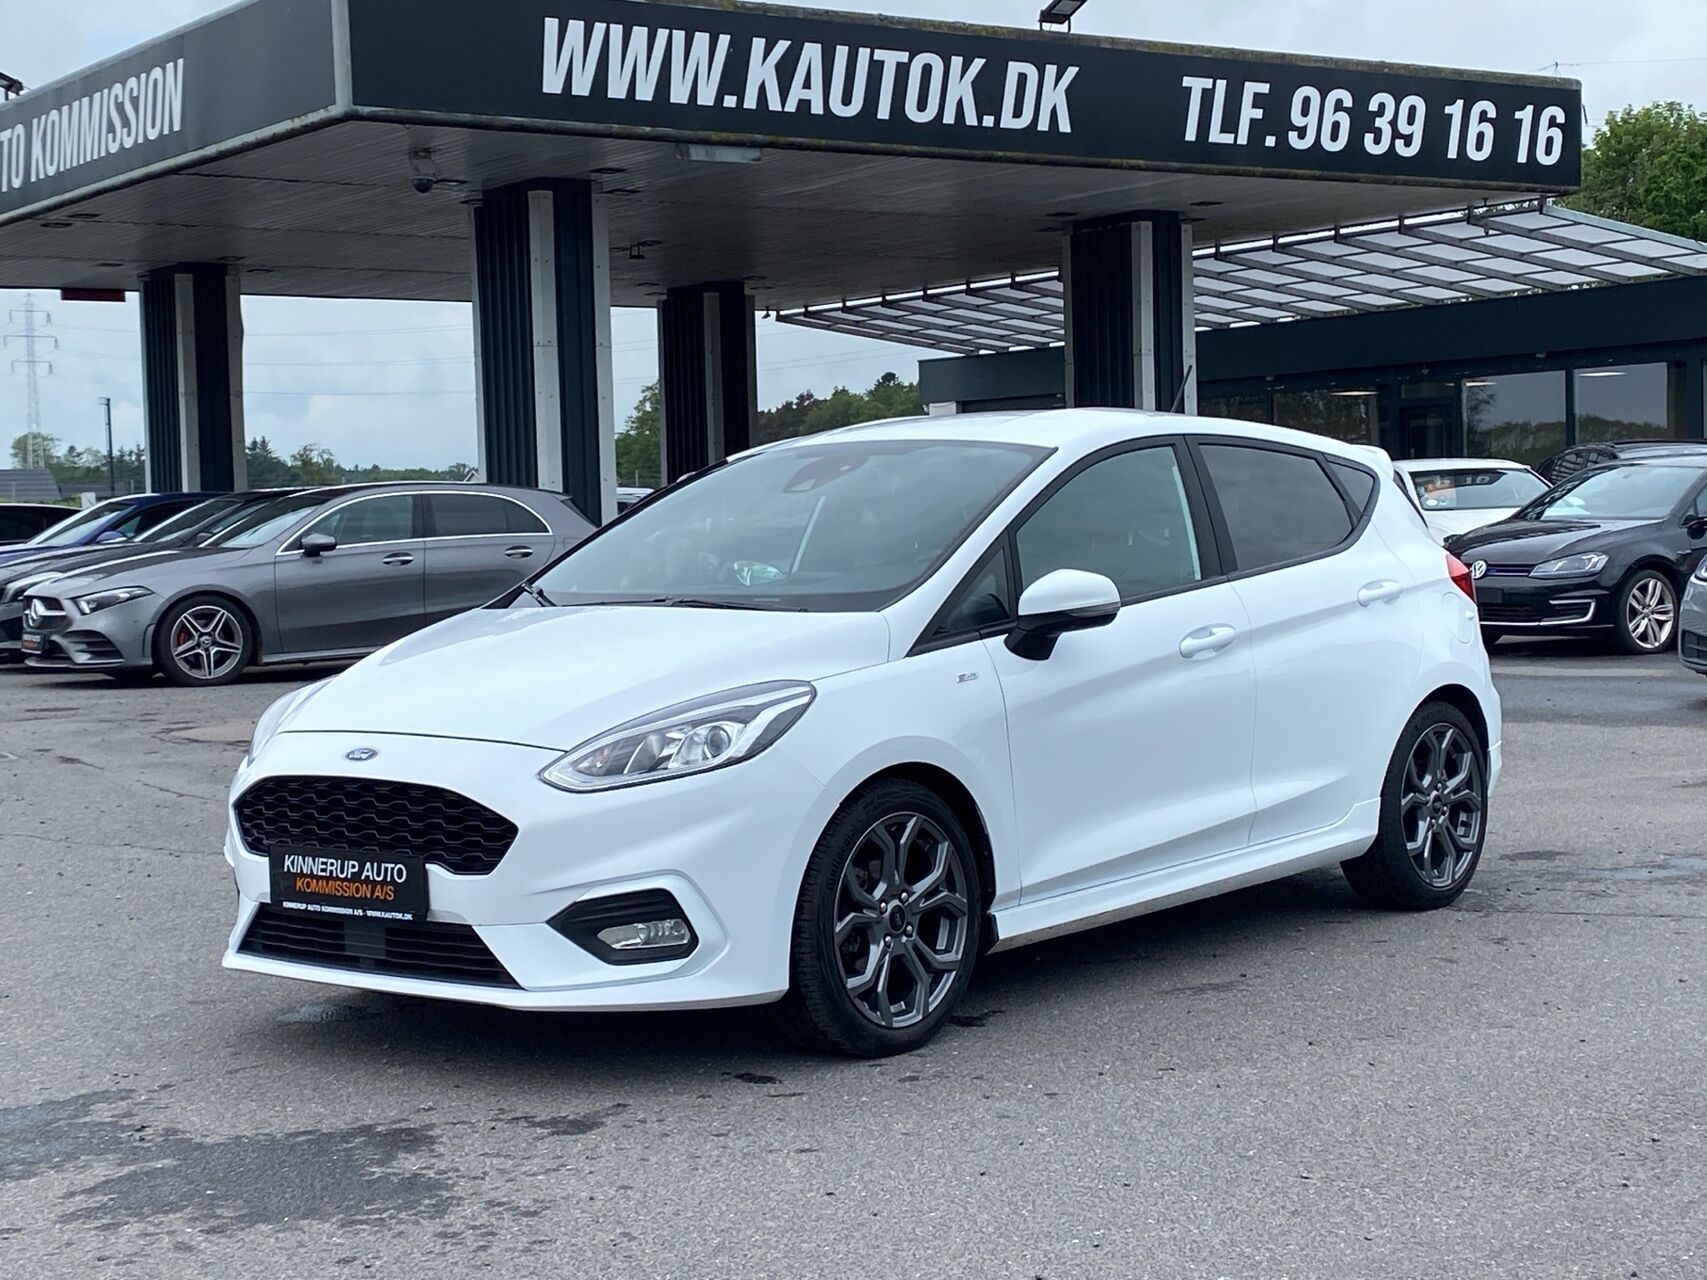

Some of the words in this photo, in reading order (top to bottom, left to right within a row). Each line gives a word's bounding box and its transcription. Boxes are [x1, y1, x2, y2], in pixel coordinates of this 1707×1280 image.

[542, 17, 1080, 133] WWW.KAUTOK.DK
[0, 124, 25, 192] TO
[30, 58, 184, 183] KOMMISSION
[1182, 76, 1276, 147] TLF.
[1288, 86, 1353, 152] 96
[1364, 92, 1426, 157] 39
[1444, 99, 1497, 161] 16
[1514, 105, 1566, 166] 16
[283, 854, 359, 879] KINNERUP
[361, 862, 407, 883] AUTO
[296, 877, 371, 898] KOMMISSION
[373, 885, 395, 900] A/S
